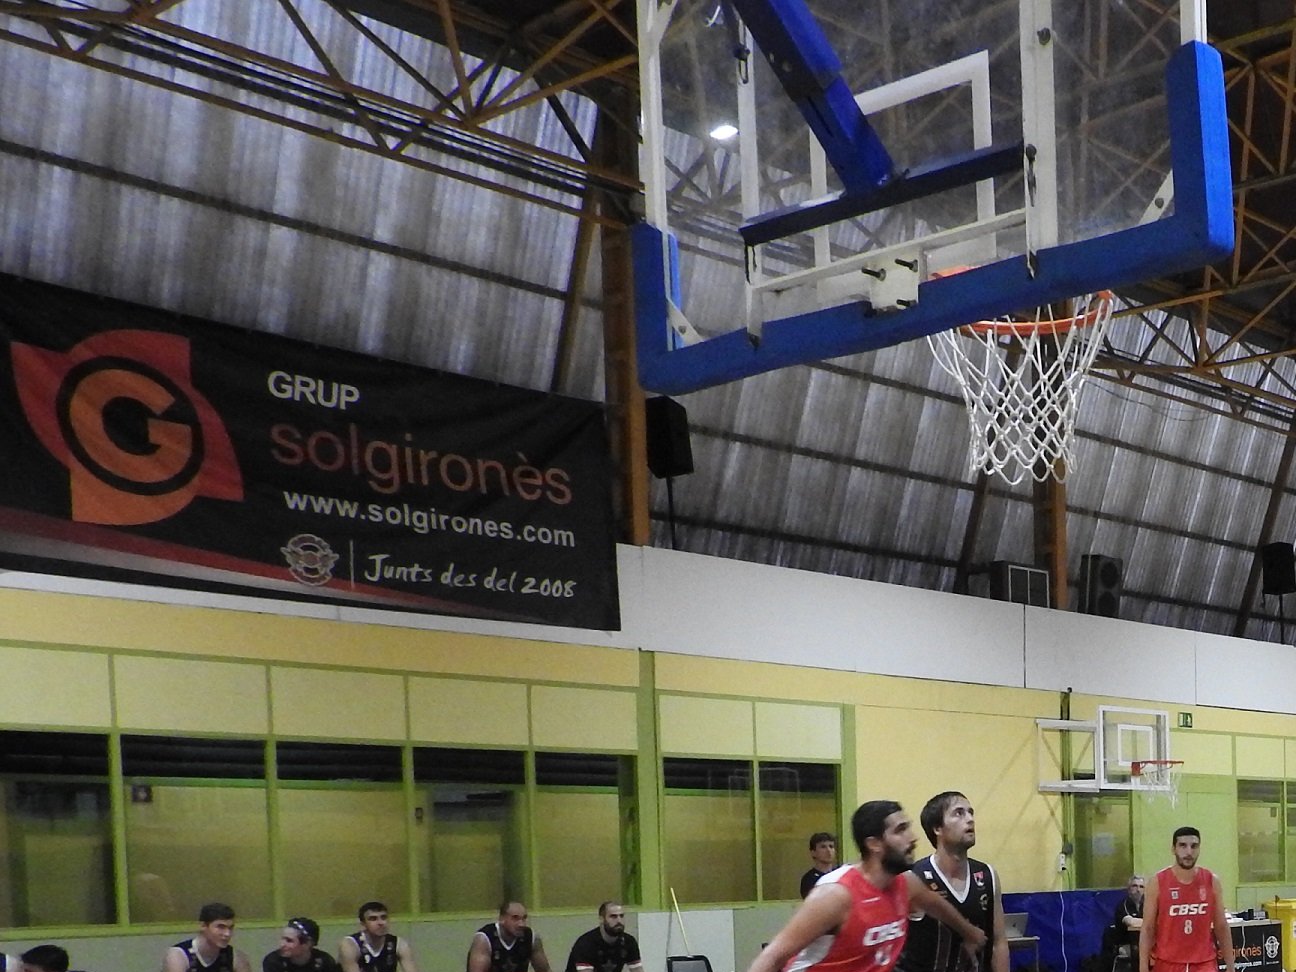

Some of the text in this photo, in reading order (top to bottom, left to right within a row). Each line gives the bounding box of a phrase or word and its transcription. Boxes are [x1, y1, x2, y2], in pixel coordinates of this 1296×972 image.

[267, 370, 360, 410] GRUP
[270, 422, 573, 505] solgironès
[282, 491, 575, 547] www.solgirones.com
[364, 553, 577, 598] Junts des del 2008
[1169, 902, 1209, 917] CBSC
[1184, 919, 1193, 935] 8
